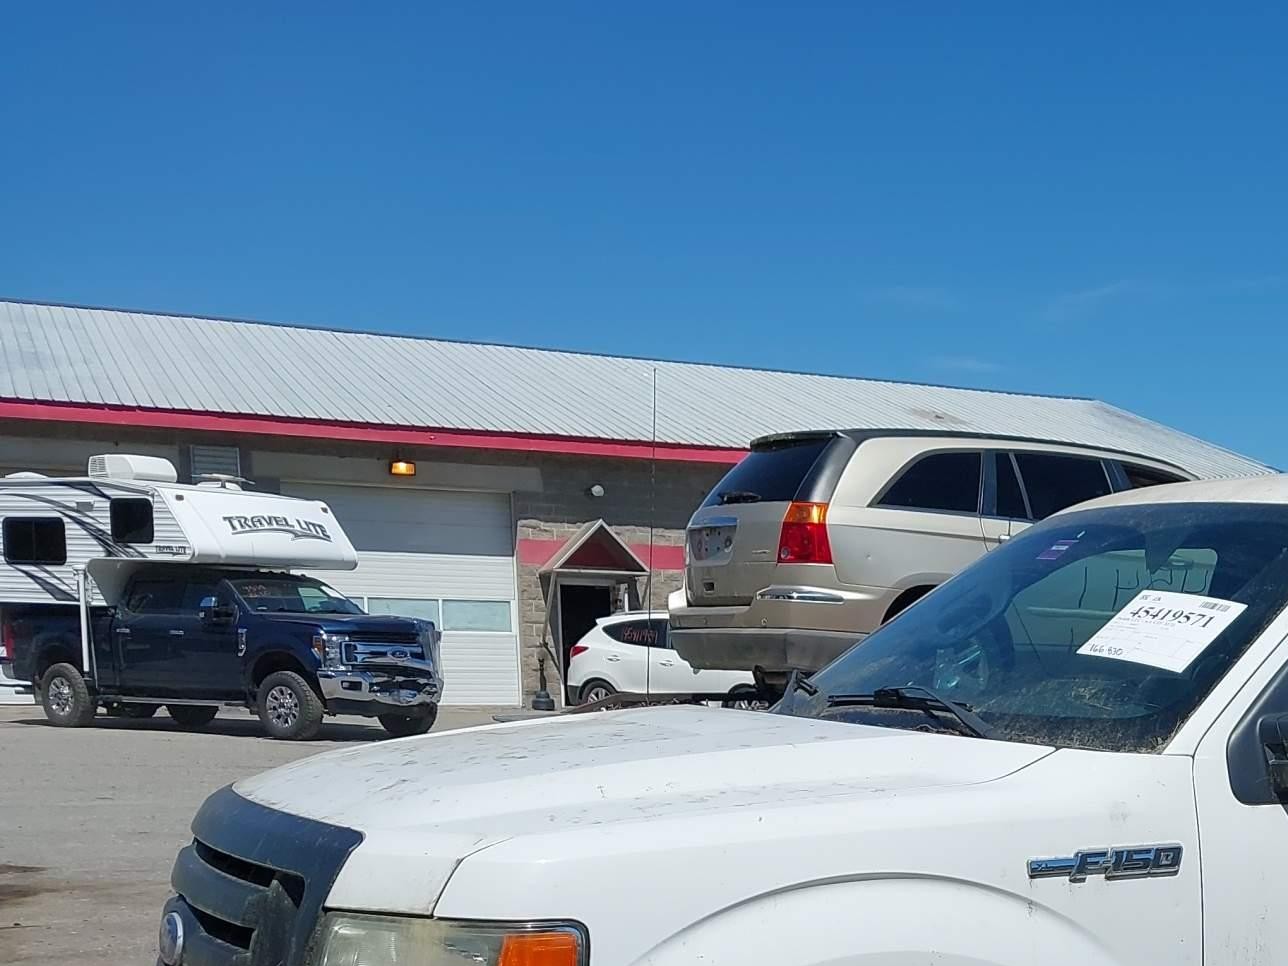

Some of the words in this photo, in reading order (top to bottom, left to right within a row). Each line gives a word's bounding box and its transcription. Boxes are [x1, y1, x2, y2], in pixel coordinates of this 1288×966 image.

[222, 515, 295, 531] TRAVEL
[295, 518, 331, 539] LITE
[1130, 606, 1215, 629] 45419571
[1069, 846, 1183, 882] F-150
